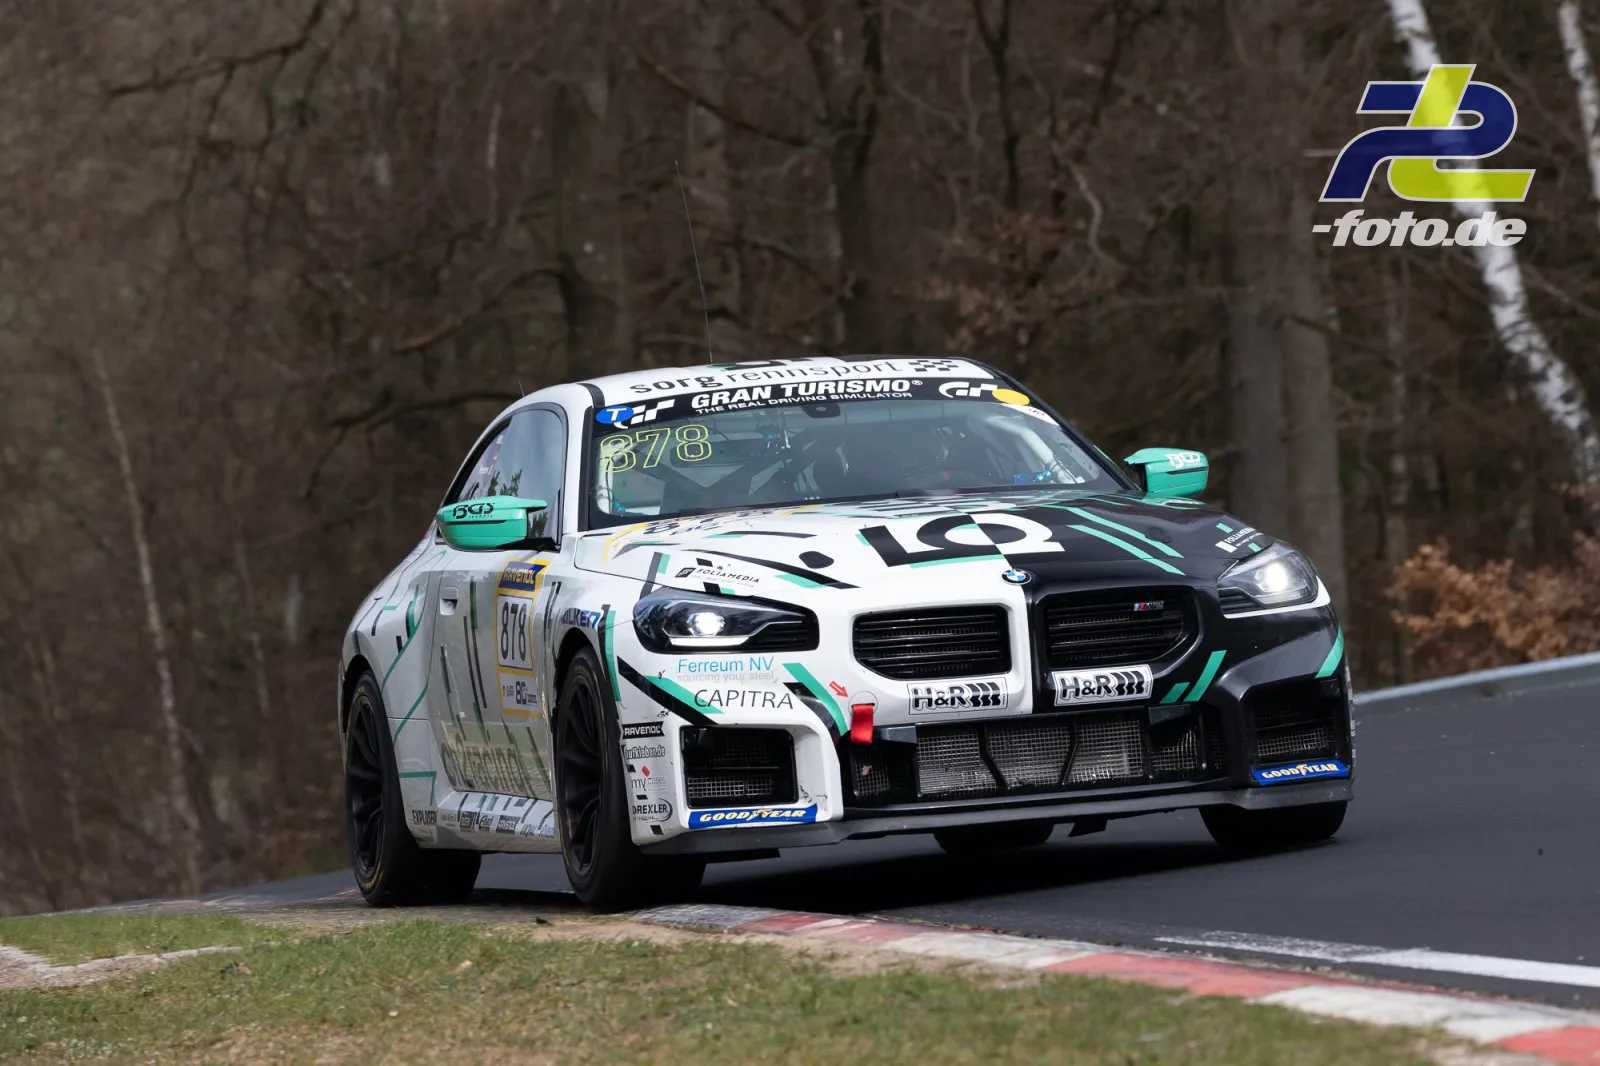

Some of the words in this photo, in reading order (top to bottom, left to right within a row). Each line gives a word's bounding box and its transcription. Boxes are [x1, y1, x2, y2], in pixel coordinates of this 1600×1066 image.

[630, 376, 723, 393] sorg
[727, 361, 904, 382] rennsport
[691, 385, 772, 409] GRAN
[695, 405, 725, 414] THE
[728, 400, 767, 410] REAL
[768, 395, 827, 405] DRIVING
[830, 392, 913, 400] SIMULATOR
[600, 424, 712, 473] 878
[697, 568, 760, 584] FOLIAMEDIA
[500, 601, 527, 662] 878
[678, 658, 744, 673] Ferreum
[749, 656, 774, 671] NV
[677, 673, 720, 684] sourcing
[723, 673, 746, 684] your
[1060, 675, 1116, 700] H&R
[694, 689, 794, 710] CAPITRA
[913, 685, 970, 711] H&R
[624, 725, 661, 736] RAVENOL
[1262, 763, 1339, 779] GOODYEAR
[632, 803, 668, 815] DREXLER
[700, 804, 807, 822] GOODYEAR
